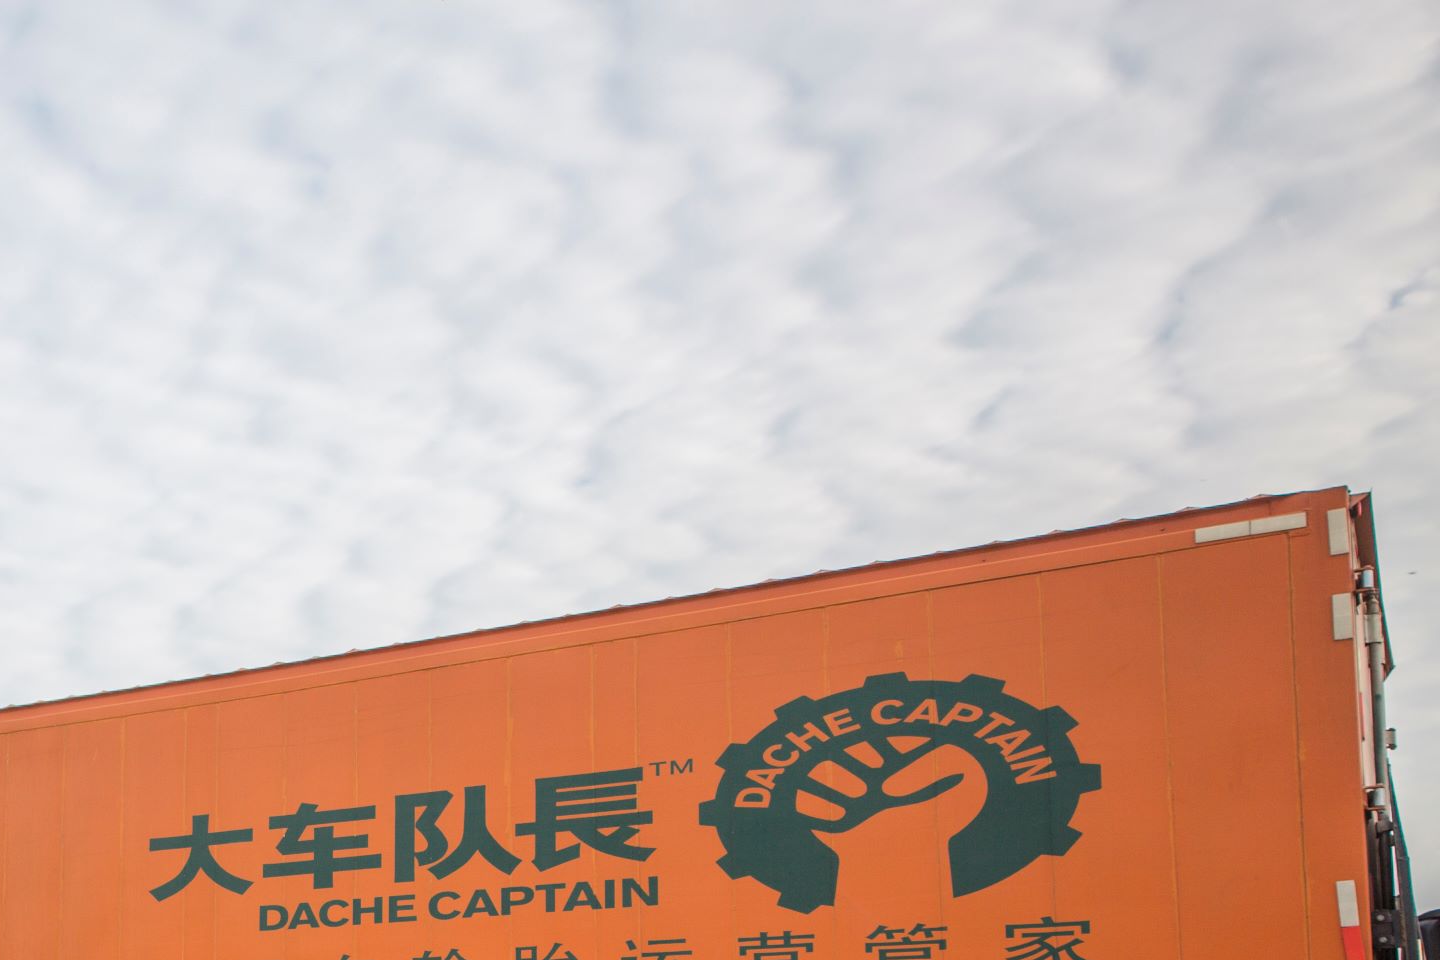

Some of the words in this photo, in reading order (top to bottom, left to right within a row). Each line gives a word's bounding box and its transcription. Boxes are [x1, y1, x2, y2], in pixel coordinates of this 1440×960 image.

[648, 758, 694, 778] TM
[734, 708, 861, 809] DACHE
[870, 698, 1057, 785] CAPTAIN
[148, 766, 657, 903] 大车队長
[259, 894, 417, 931] DACHE
[427, 875, 660, 919] CAPTAIN
